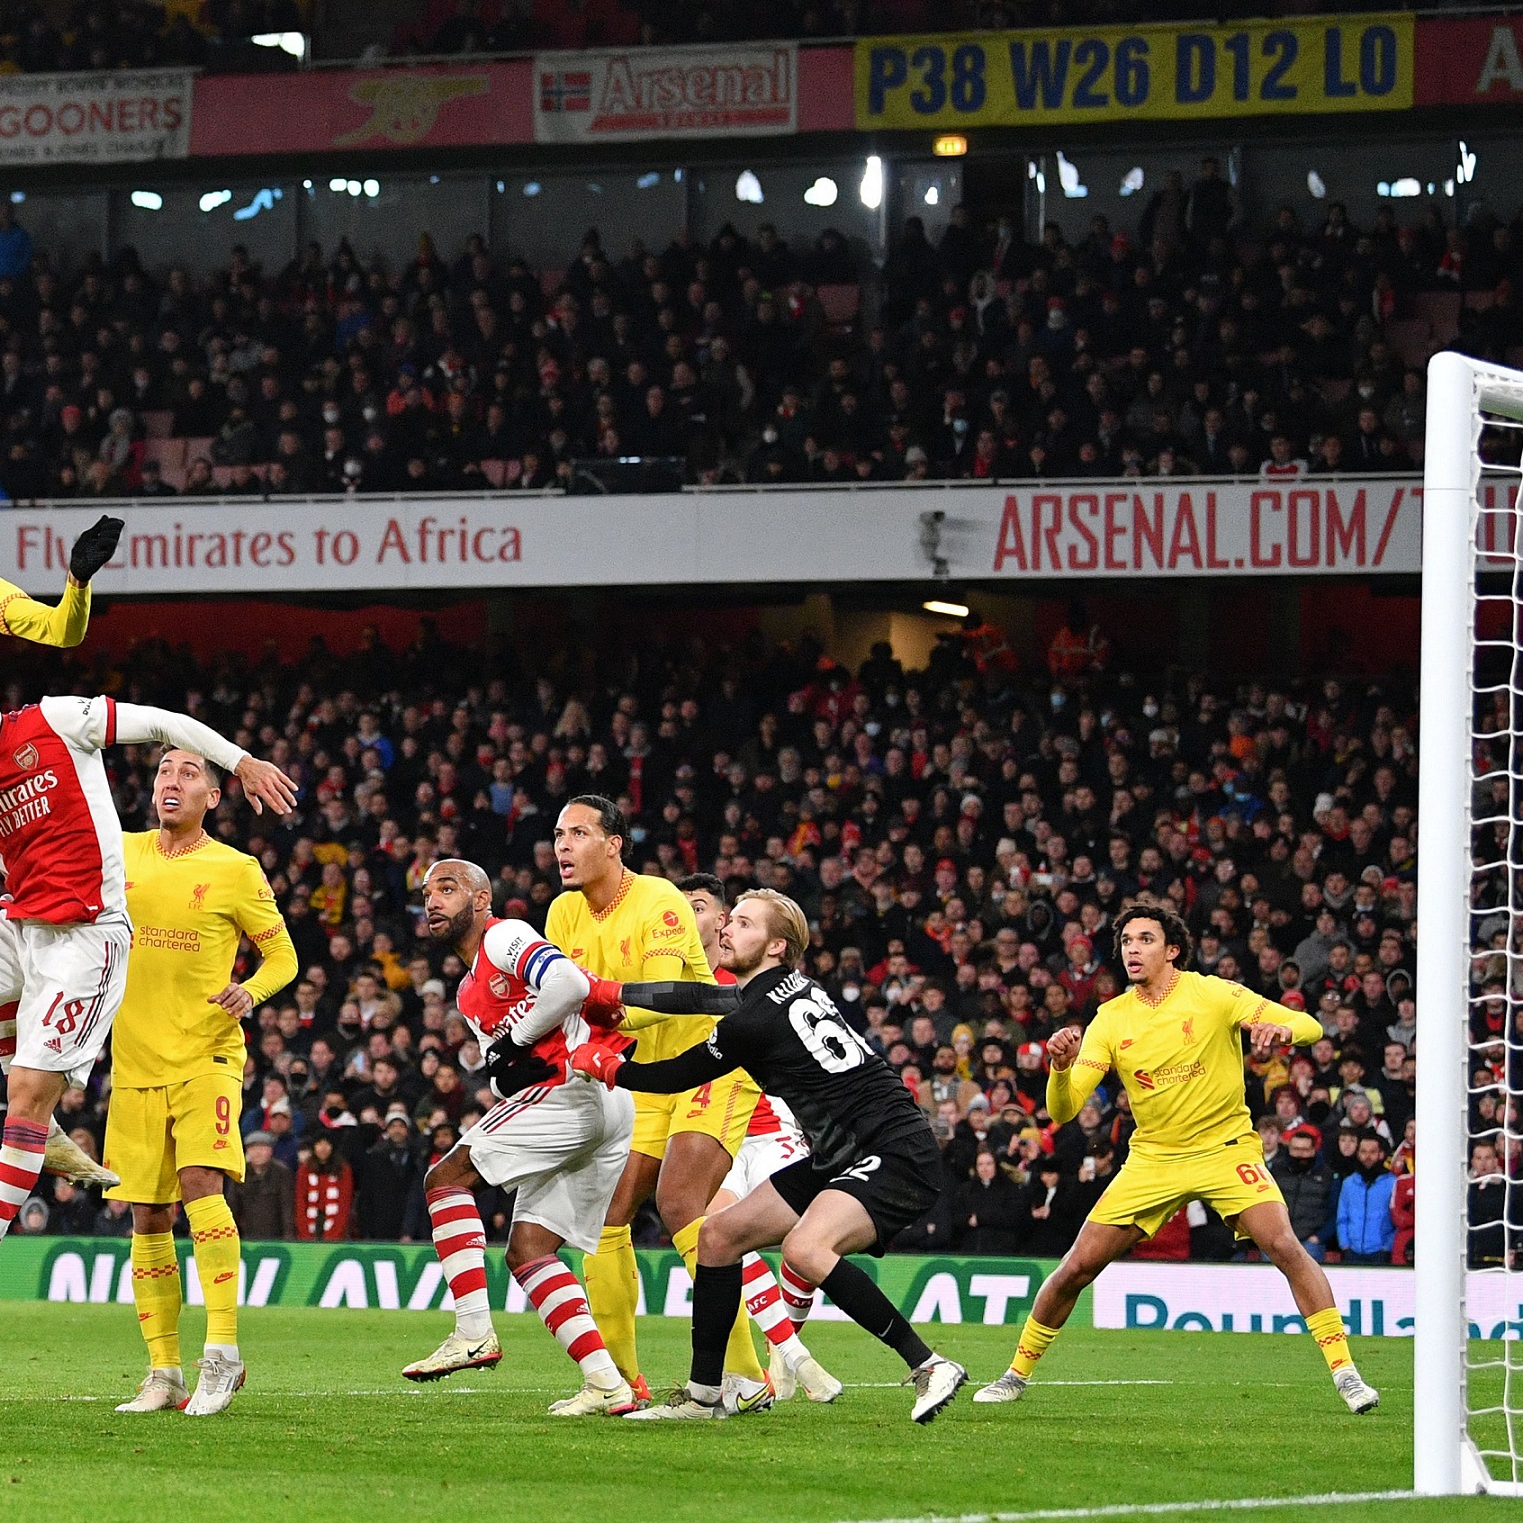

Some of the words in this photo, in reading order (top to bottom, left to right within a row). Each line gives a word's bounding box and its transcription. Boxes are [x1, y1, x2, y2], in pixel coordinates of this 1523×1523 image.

[601, 48, 789, 112] Arsenal
[868, 43, 987, 115] P38
[1009, 36, 1150, 110] W26
[1175, 29, 1299, 103] D12
[314, 526, 361, 566] to
[376, 516, 522, 565] Africa
[11, 795, 51, 830] BETTER
[138, 936, 201, 952] chartered
[139, 925, 199, 942] standard
[506, 936, 524, 957] VISIT
[41, 990, 86, 1035] 18
[1153, 1059, 1201, 1078] standard
[1157, 1066, 1206, 1086] chartered
[691, 1081, 712, 1109] 4
[215, 1095, 230, 1136] 9
[747, 1295, 769, 1312] AFC
[909, 1271, 1031, 1325] AT
